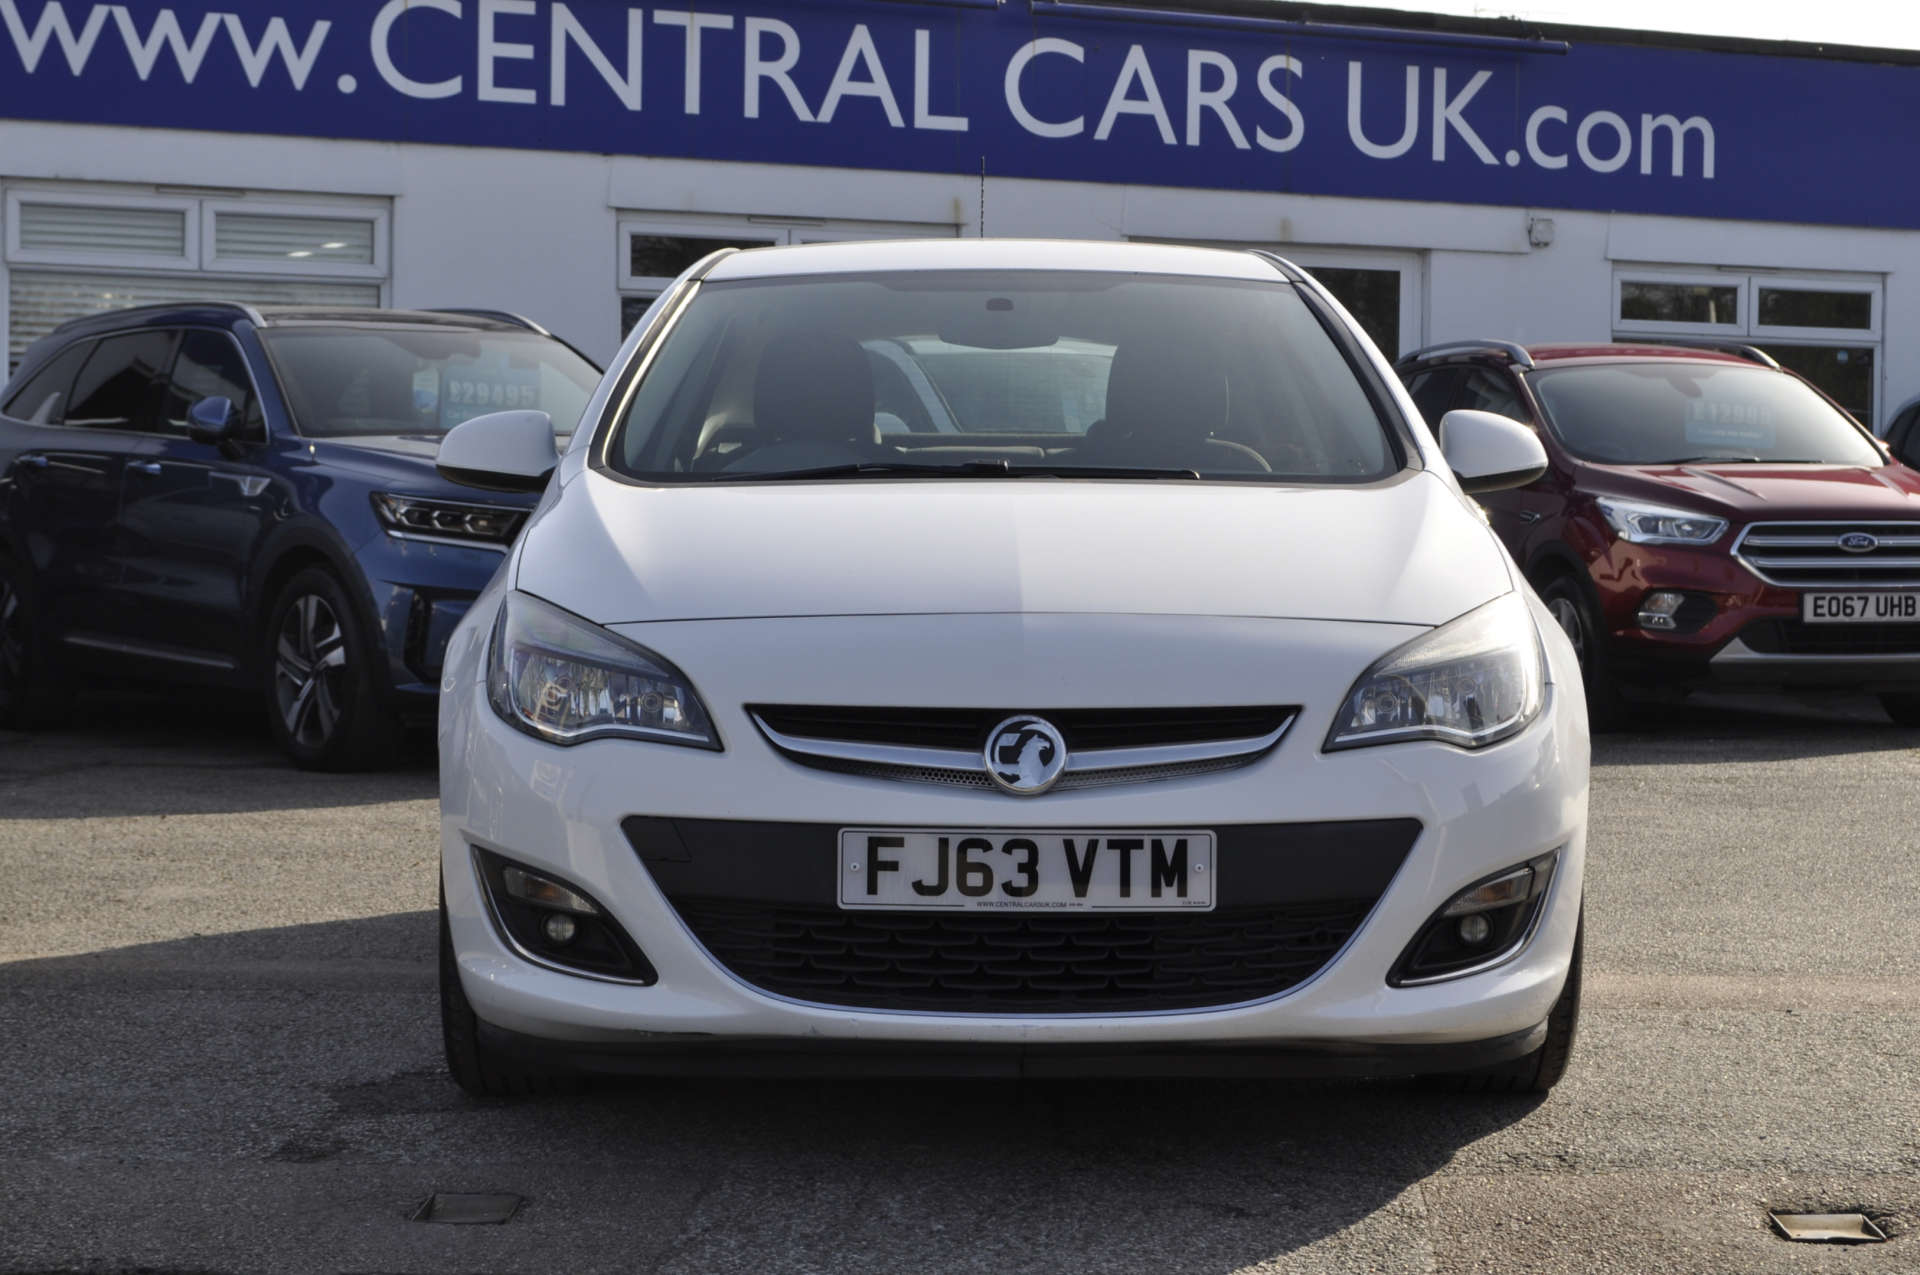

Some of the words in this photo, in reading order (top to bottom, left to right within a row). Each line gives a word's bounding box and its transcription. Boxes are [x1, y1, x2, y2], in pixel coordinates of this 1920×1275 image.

[0, 0, 969, 131] www.CENTRAL
[1004, 37, 1305, 153] CARS
[1347, 60, 1716, 179] UK.com
[1847, 536, 1870, 547] Ford
[1813, 596, 1869, 618] EO67
[1875, 596, 1916, 618] UHB
[866, 836, 1040, 898] FJ63
[1062, 838, 1189, 899] VTM
